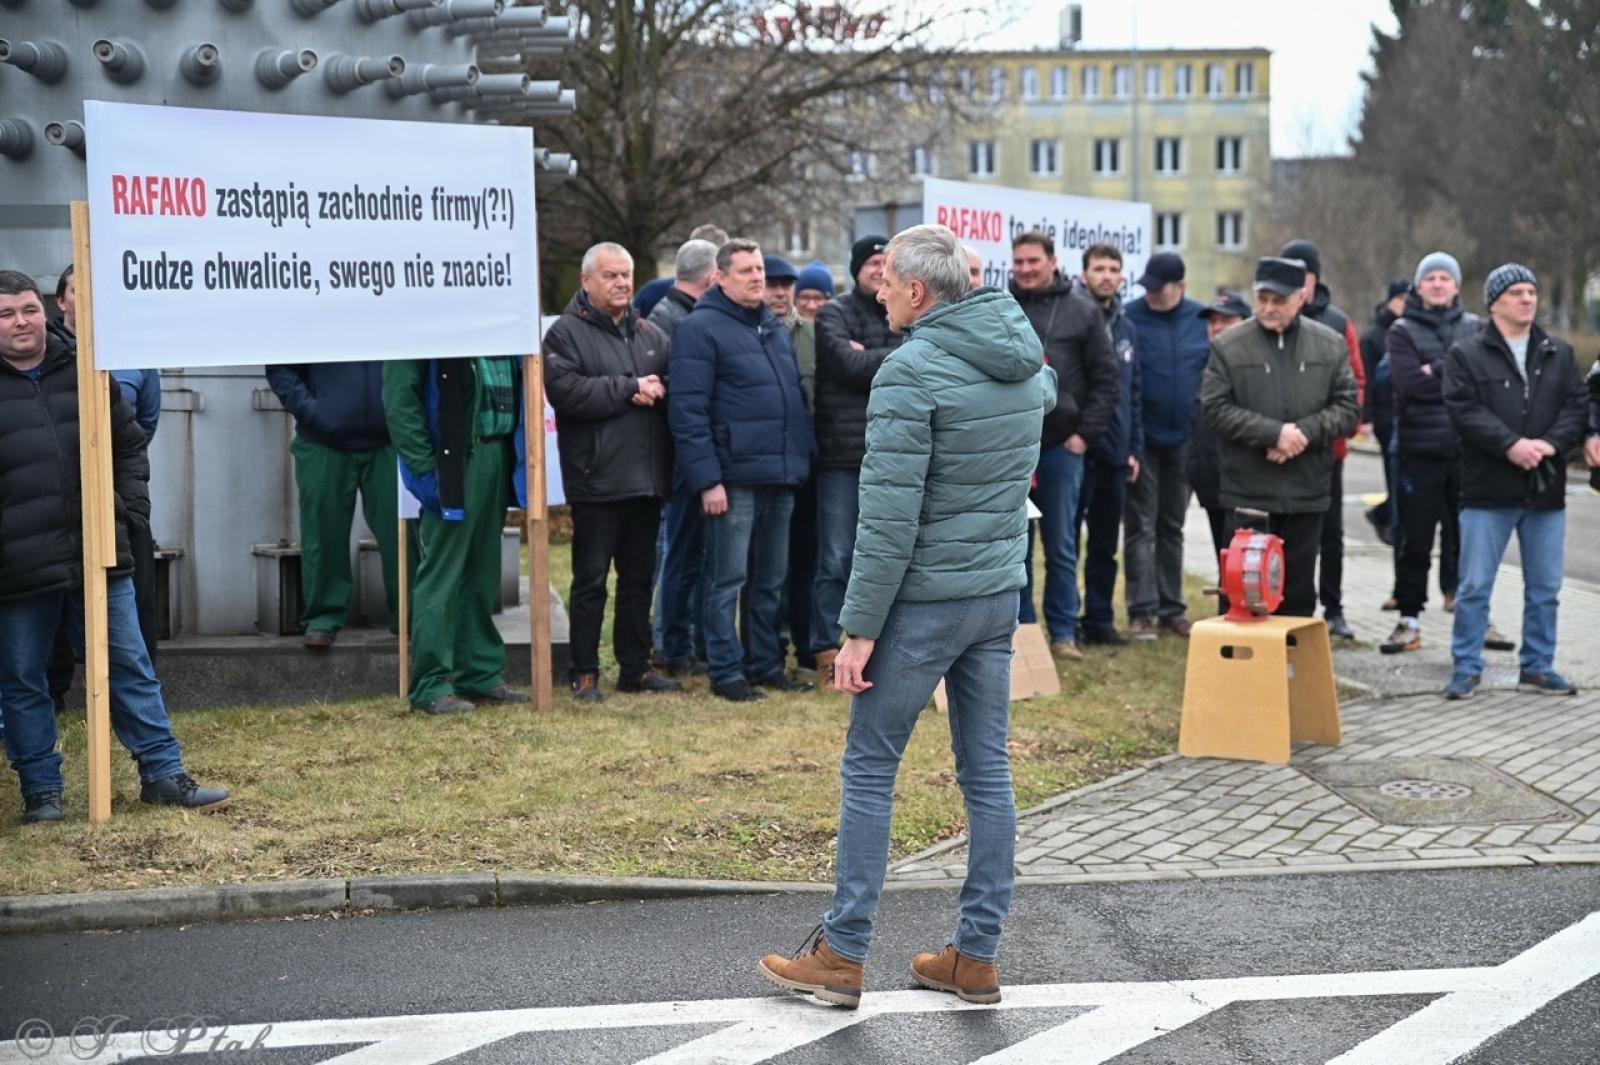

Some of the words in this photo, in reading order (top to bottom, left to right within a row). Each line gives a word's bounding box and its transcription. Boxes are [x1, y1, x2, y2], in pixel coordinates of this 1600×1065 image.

[112, 174, 206, 217] RAFAKO
[216, 181, 310, 229] zastąpią
[318, 184, 422, 222] zachodnie
[431, 186, 514, 230] firmy(?!)
[937, 205, 1003, 243] RAFAKO
[122, 249, 194, 291] Cudze
[205, 251, 320, 295] chwalicie,
[329, 260, 395, 296] swego
[404, 252, 435, 289] nie
[442, 252, 512, 288] znacie!
